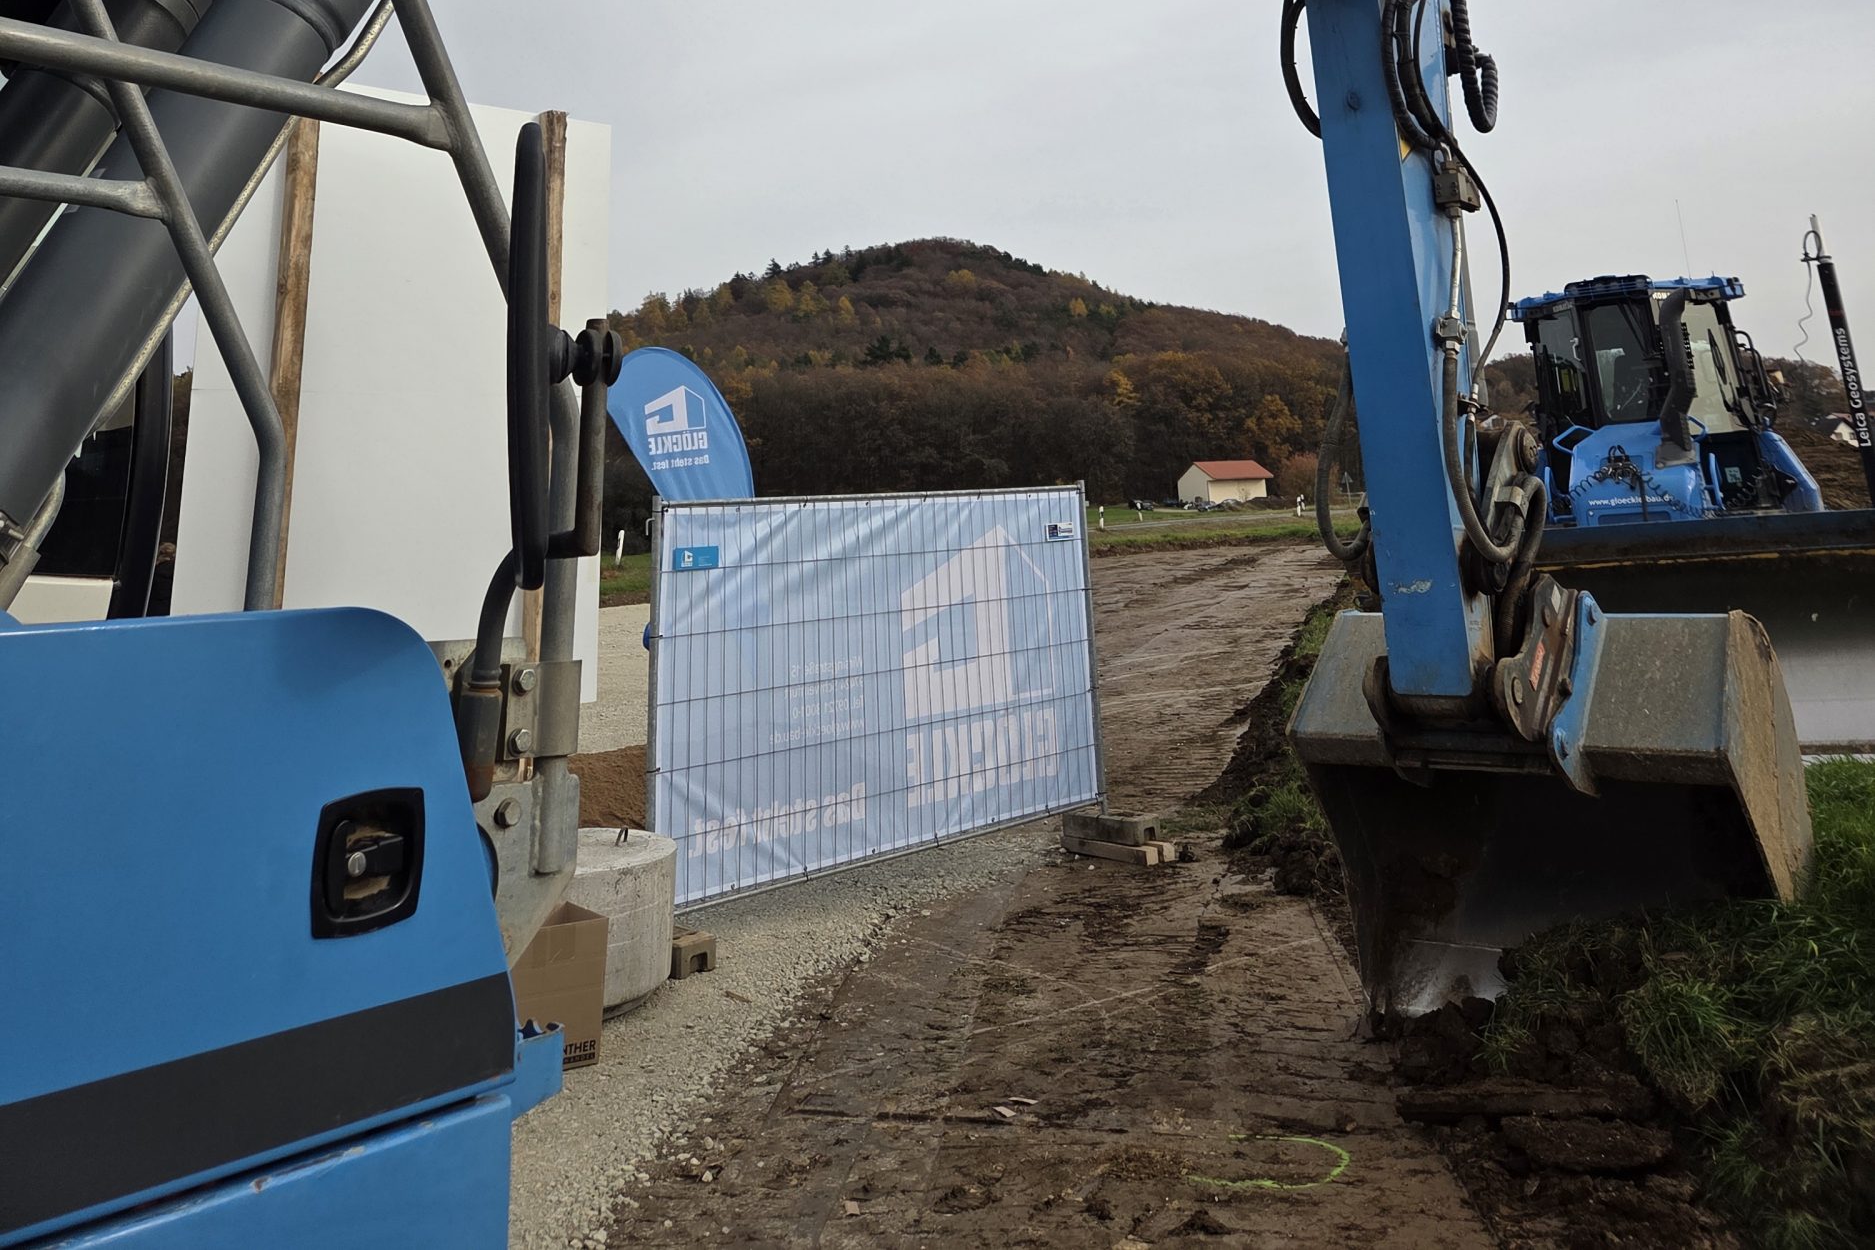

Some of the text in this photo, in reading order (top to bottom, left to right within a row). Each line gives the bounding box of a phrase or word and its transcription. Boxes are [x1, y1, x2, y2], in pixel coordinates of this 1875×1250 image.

[1836, 327, 1863, 409] Geosystems
[1856, 412, 1872, 447] Leica
[1588, 493, 1674, 507] www.gloecklebau.d
